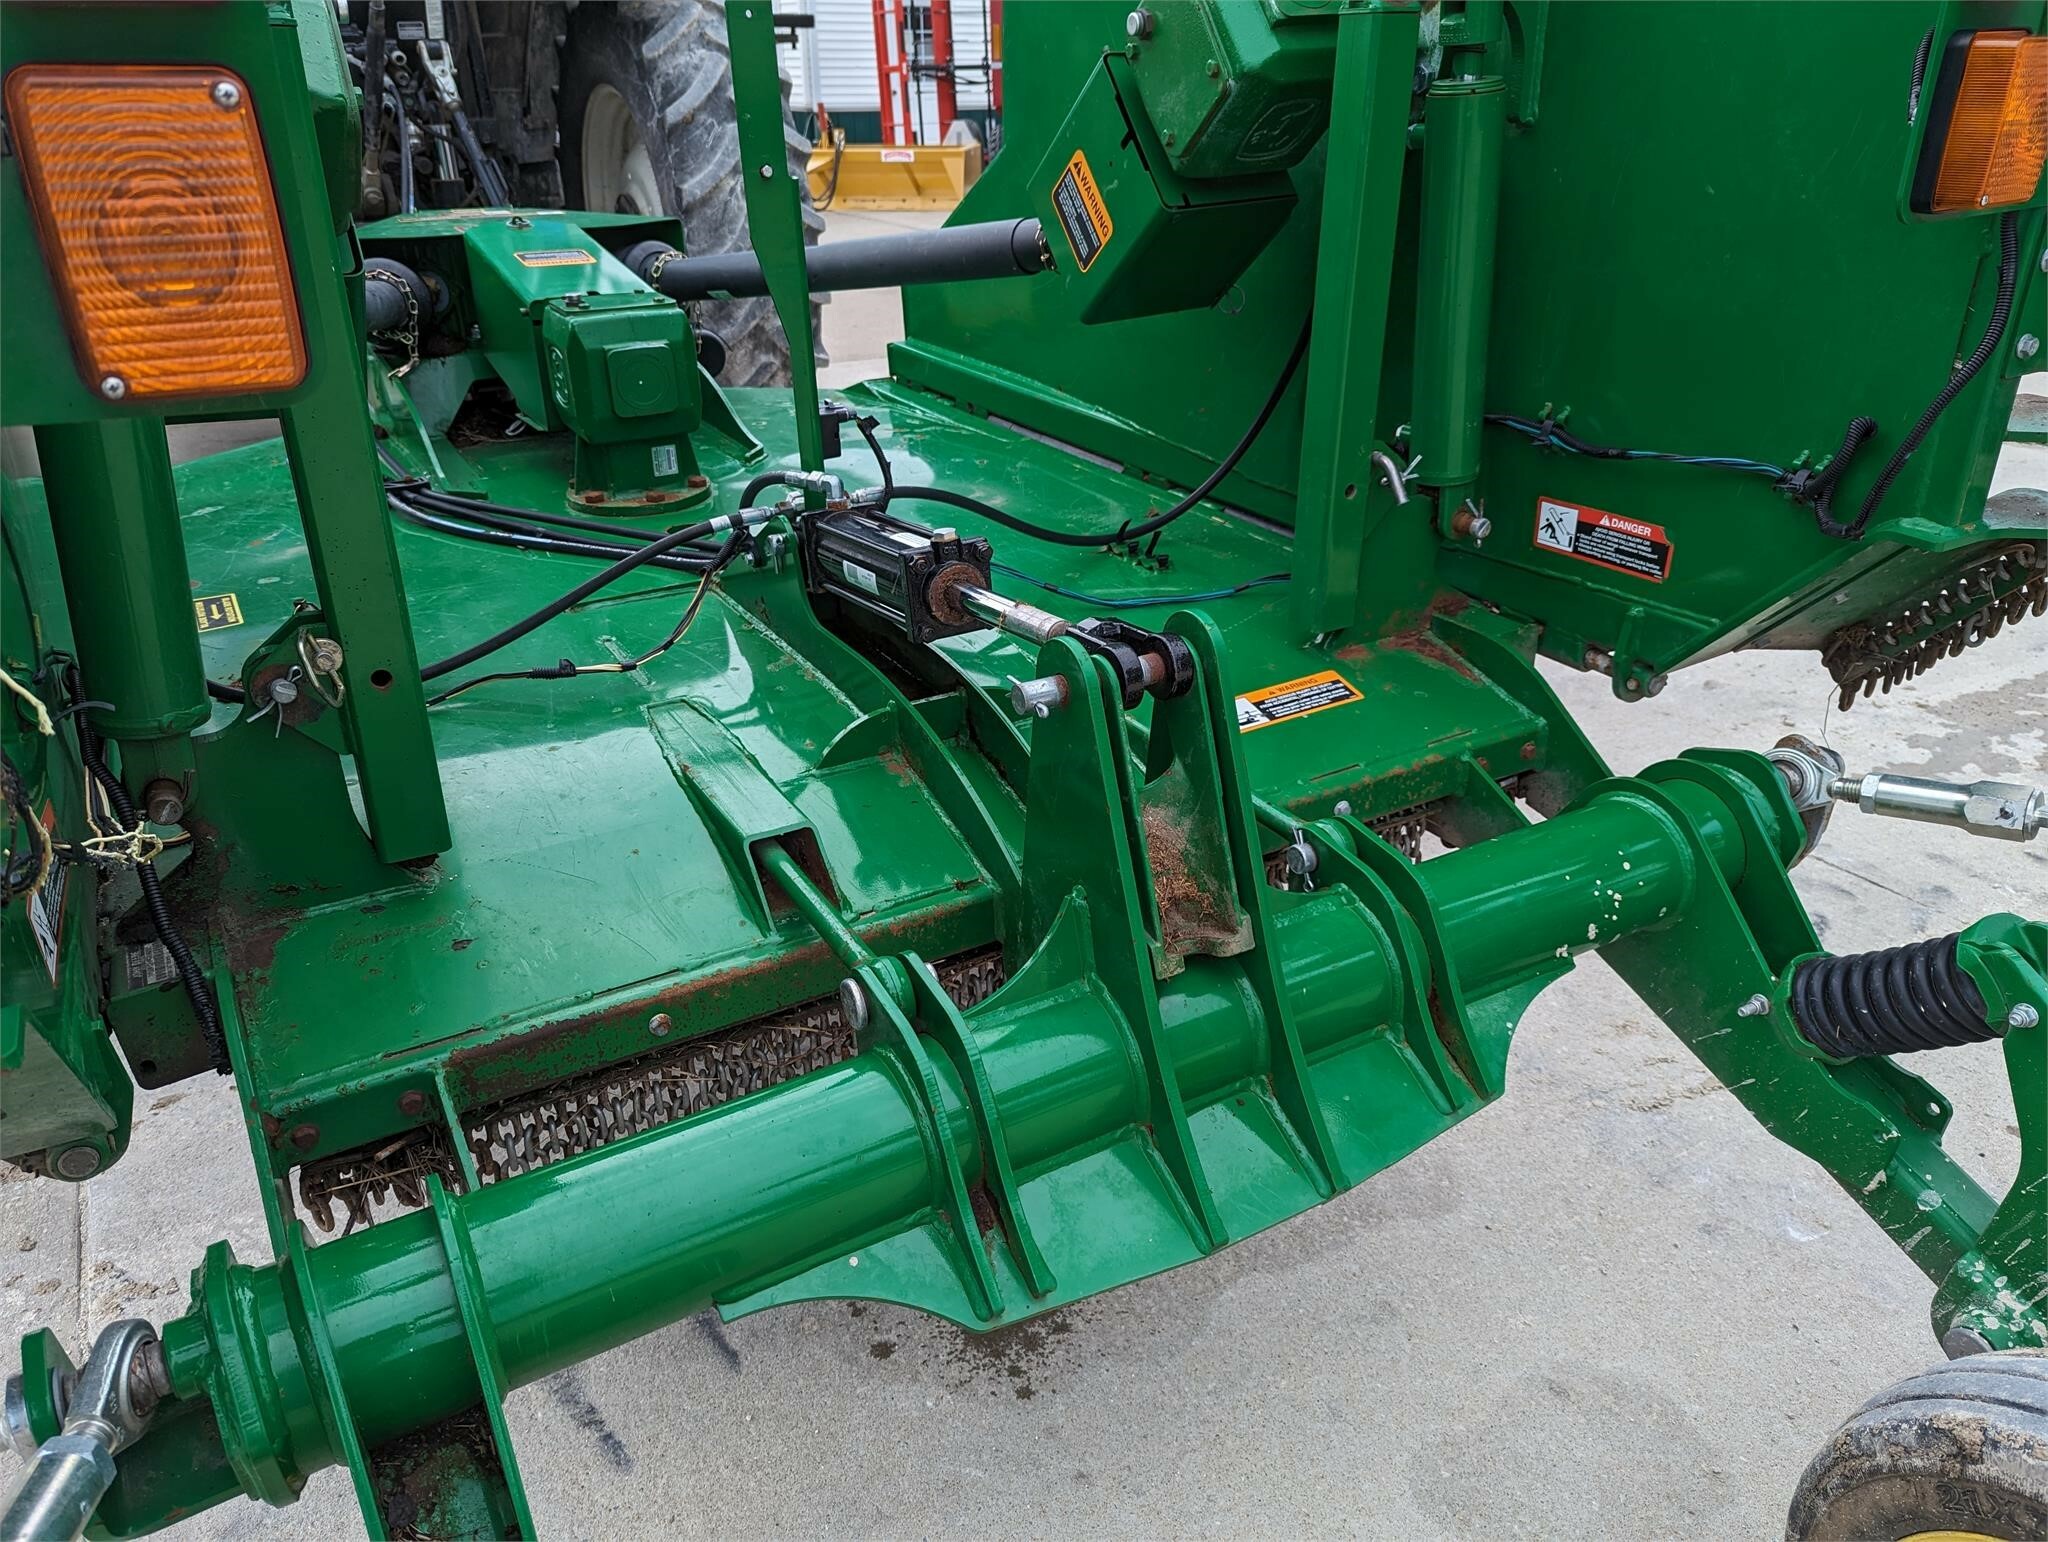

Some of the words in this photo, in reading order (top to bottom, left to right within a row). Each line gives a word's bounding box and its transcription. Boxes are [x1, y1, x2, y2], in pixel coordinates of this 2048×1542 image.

[1080, 172, 1110, 238] WARNING
[1611, 518, 1651, 536] DANGER
[1276, 677, 1319, 694] WARNING
